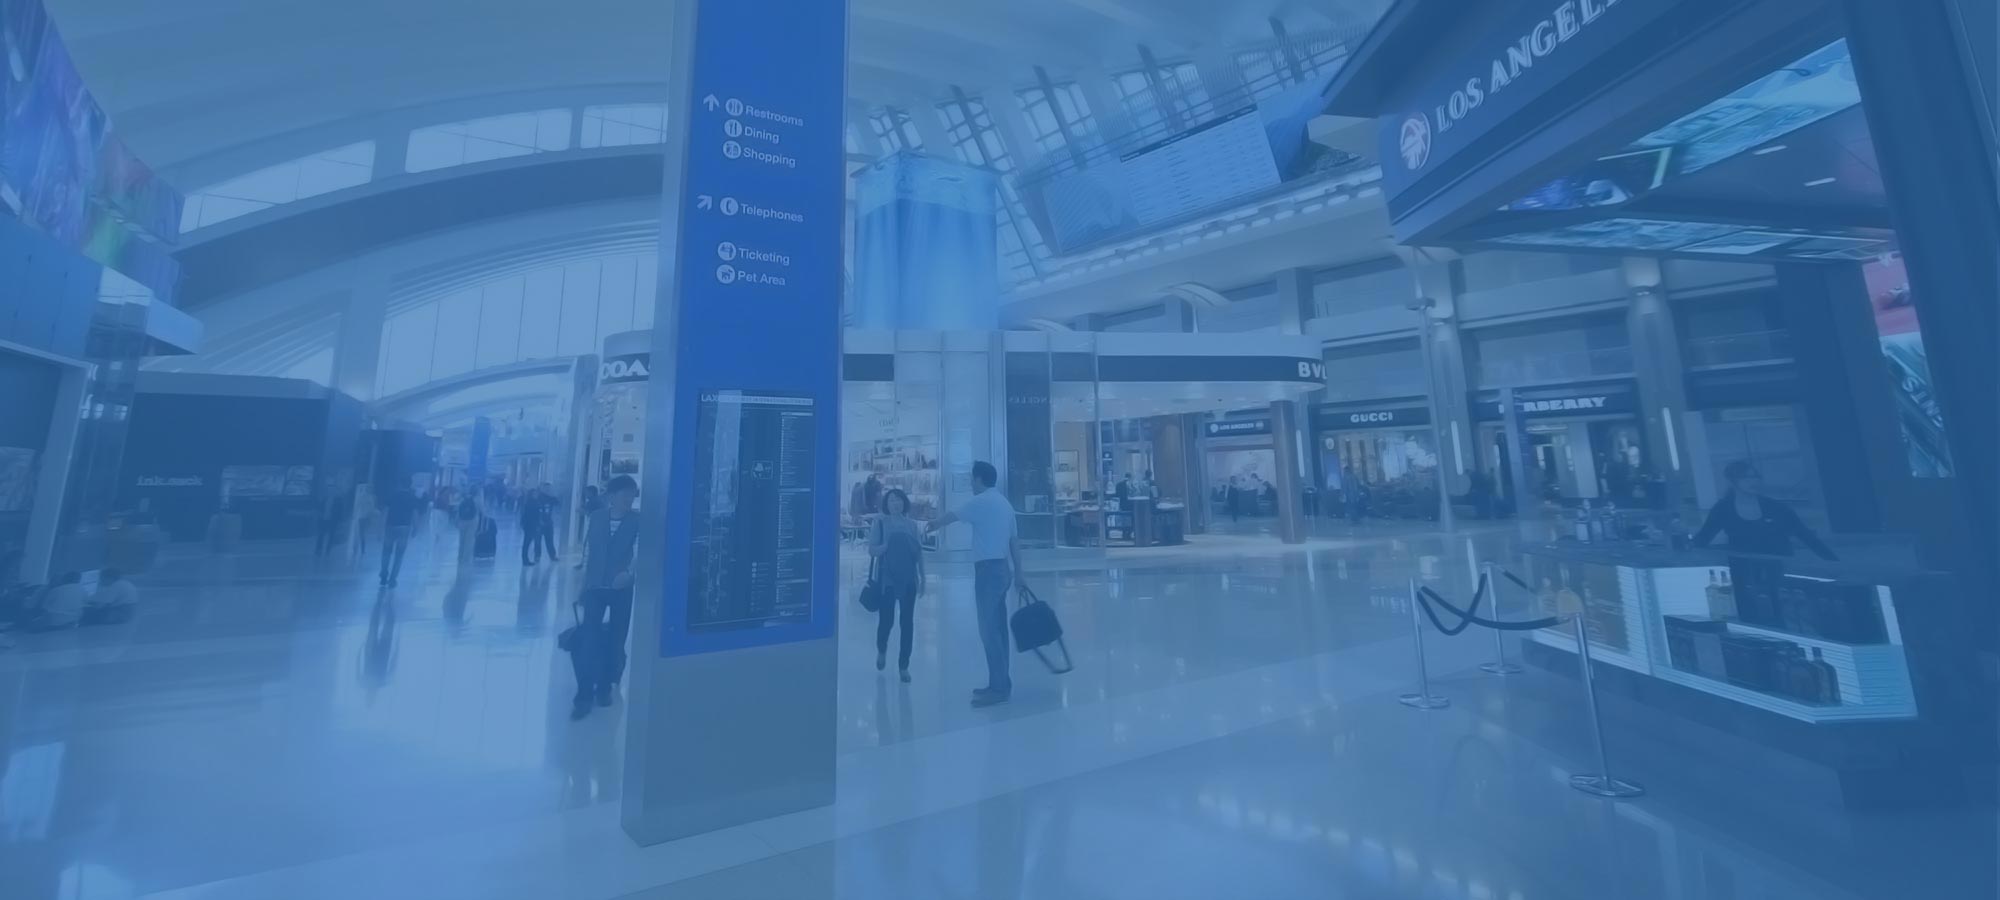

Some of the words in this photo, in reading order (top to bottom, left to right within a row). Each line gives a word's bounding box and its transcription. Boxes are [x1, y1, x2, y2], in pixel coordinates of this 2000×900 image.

[1434, 77, 1484, 134] LOS
[1489, 0, 1625, 94] ANGEL
[745, 105, 804, 127] Restrooms
[744, 126, 780, 144] Dining
[743, 147, 796, 169] Shopping
[740, 203, 804, 223] Telephones
[738, 247, 790, 267] Ticketing
[737, 270, 757, 284] Pet
[760, 273, 786, 286] Area
[600, 359, 651, 380] COA
[1498, 396, 1607, 414] RBERRY
[1350, 411, 1393, 423] GUCCI
